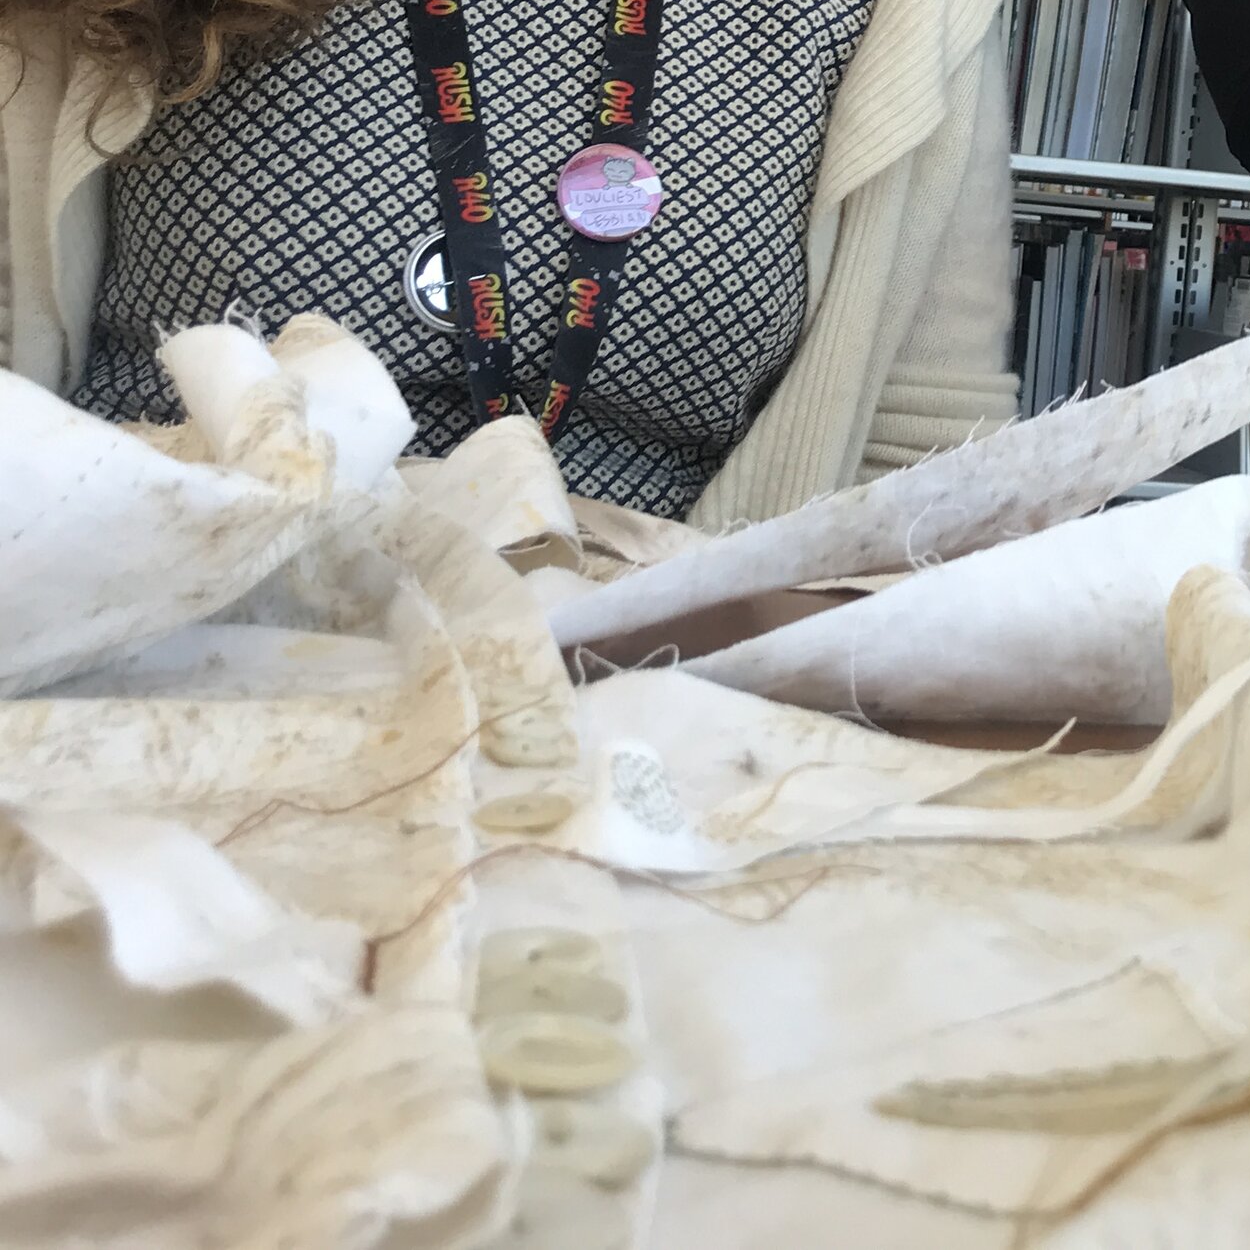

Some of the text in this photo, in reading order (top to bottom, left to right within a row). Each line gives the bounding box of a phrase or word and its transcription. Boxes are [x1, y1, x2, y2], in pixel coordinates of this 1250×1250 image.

[431, 61, 475, 126] RUSH
[599, 80, 635, 127] R40
[452, 171, 494, 224] R40
[469, 273, 506, 340] RUSH
[566, 278, 601, 329] R40
